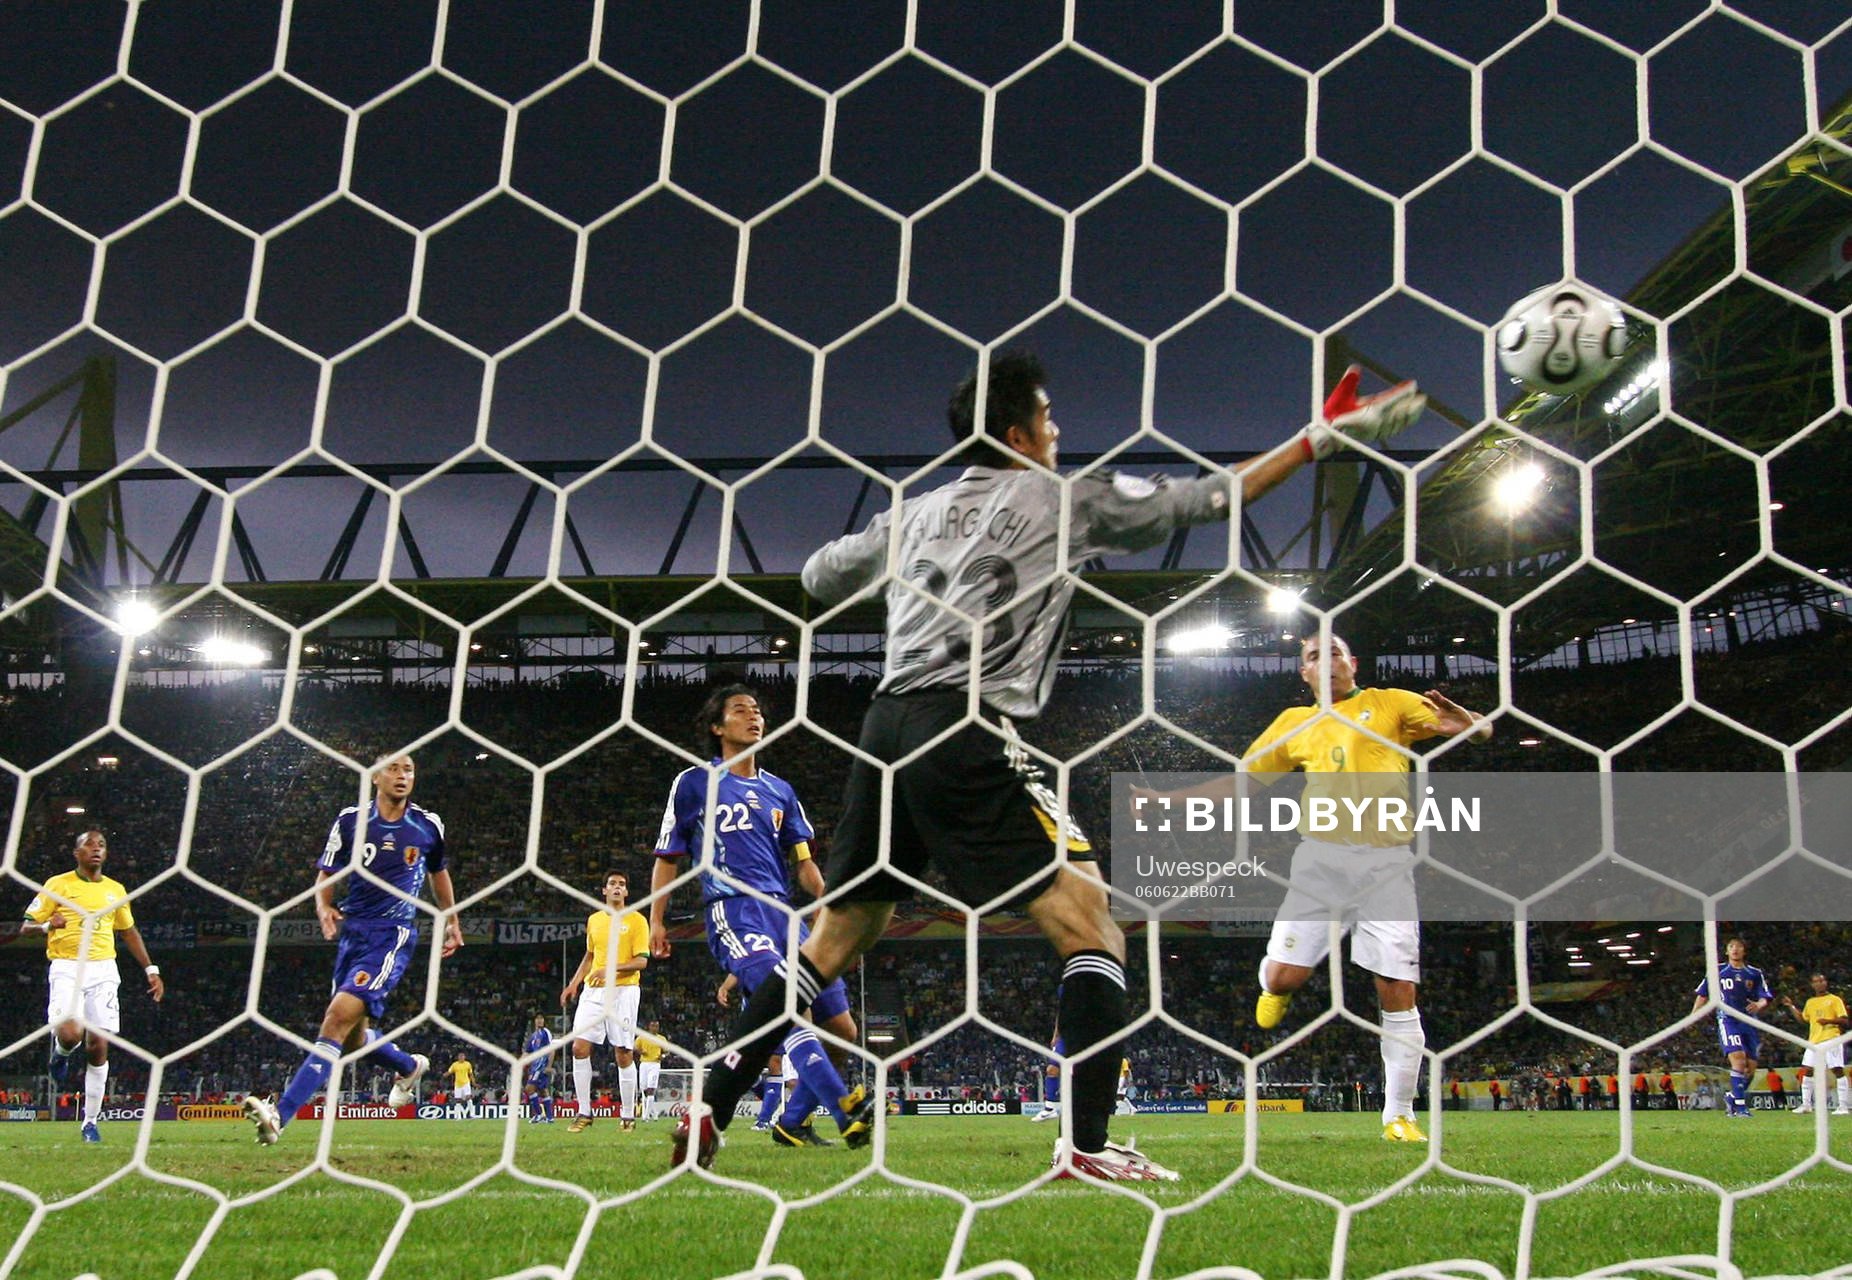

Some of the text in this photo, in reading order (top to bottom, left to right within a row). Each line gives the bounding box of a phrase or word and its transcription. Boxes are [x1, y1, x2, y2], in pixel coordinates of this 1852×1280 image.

[1332, 746, 1345, 772] 9
[716, 803, 753, 833] 22
[1721, 979, 1734, 991] 10
[1728, 1035, 1742, 1046] 10
[339, 1105, 397, 1118] Emirates
[952, 1100, 1006, 1114] adidas
